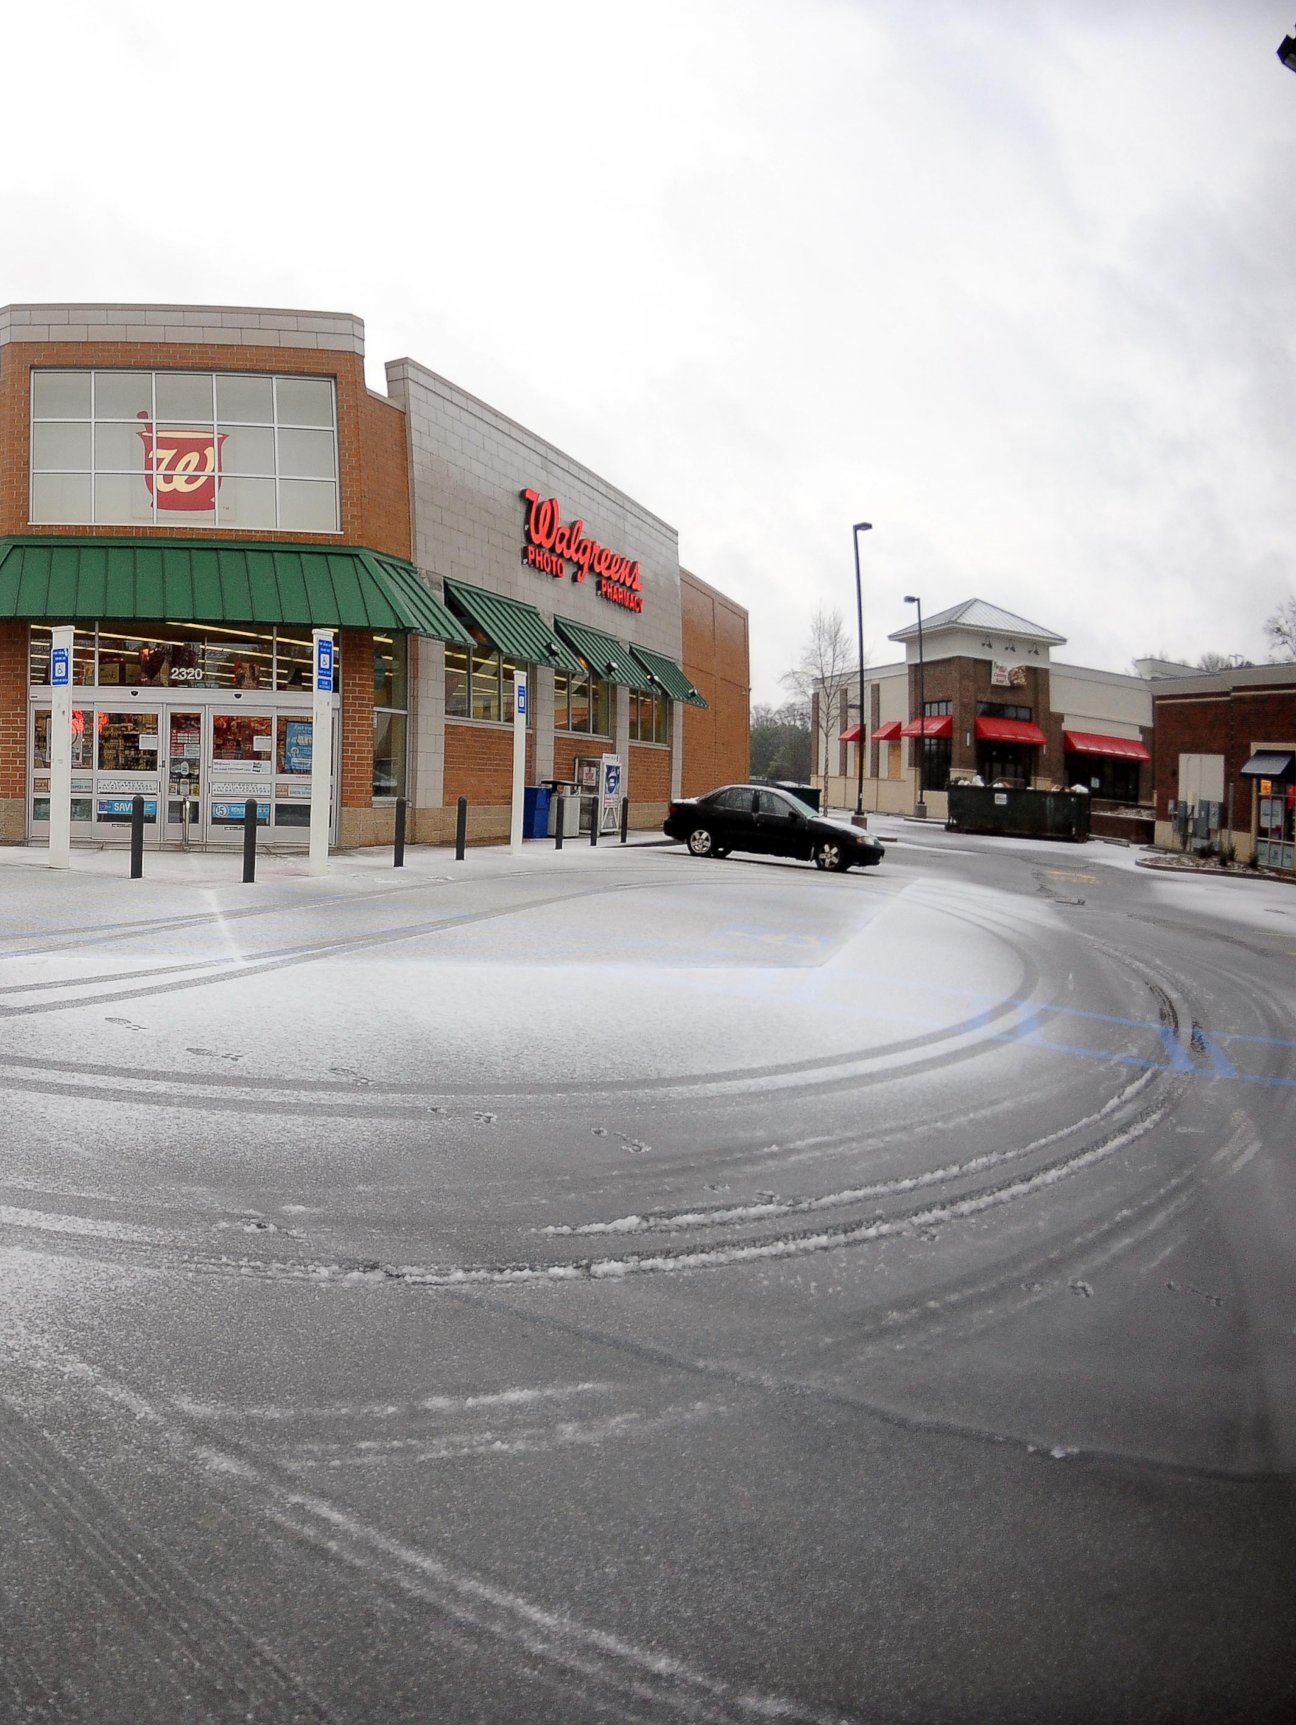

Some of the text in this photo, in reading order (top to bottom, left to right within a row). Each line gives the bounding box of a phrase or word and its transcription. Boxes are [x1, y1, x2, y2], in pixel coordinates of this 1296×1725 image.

[525, 487, 644, 592] Walgreens
[527, 546, 566, 578] PHOTO
[600, 579, 644, 614] PHARMACY
[170, 667, 203, 680] 2320
[114, 802, 133, 812] SAV
